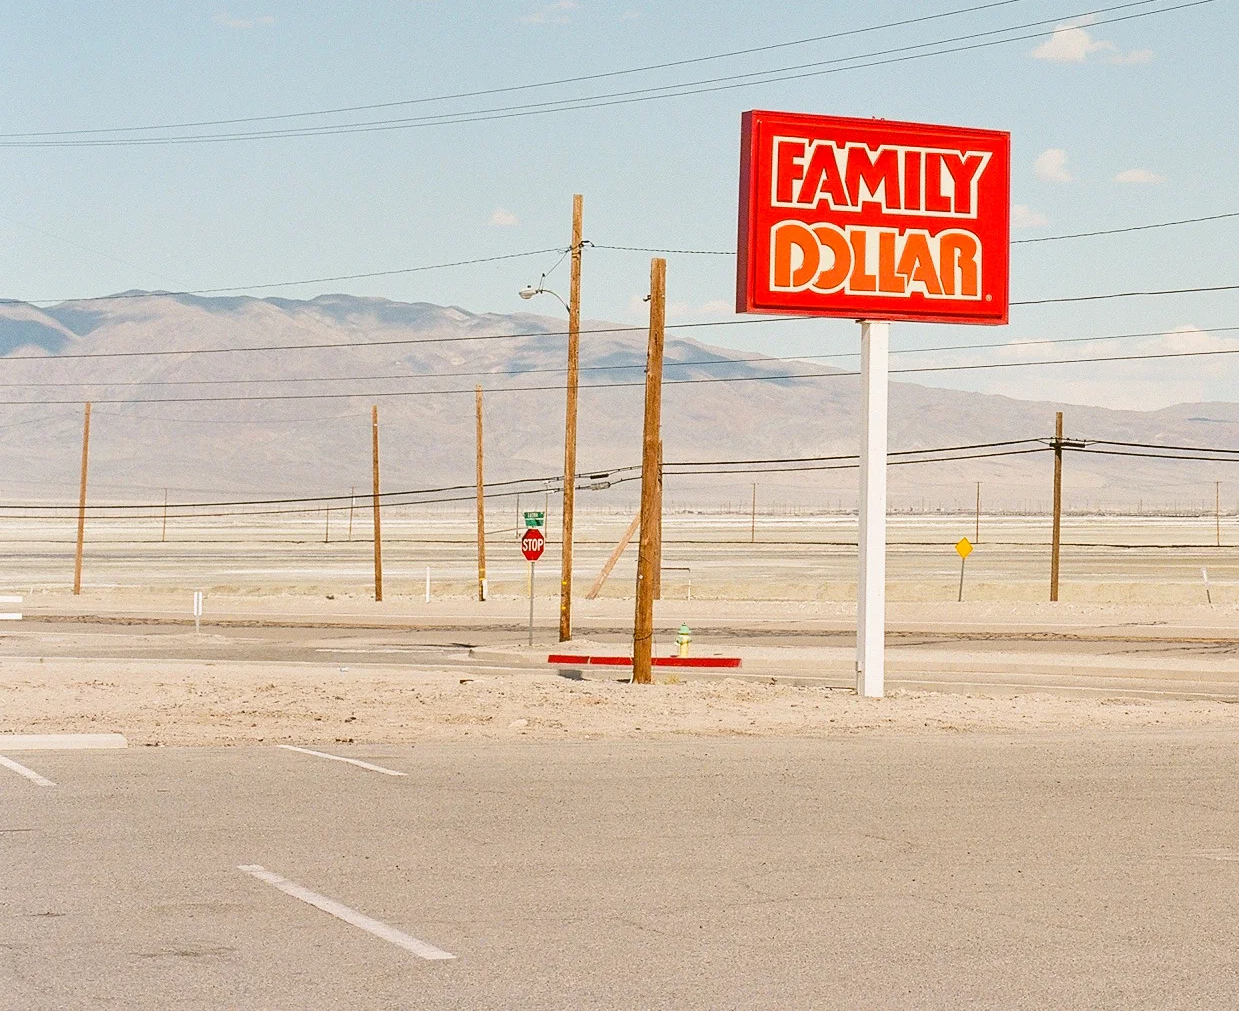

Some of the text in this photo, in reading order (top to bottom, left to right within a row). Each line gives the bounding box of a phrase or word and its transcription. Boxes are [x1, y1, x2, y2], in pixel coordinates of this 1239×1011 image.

[771, 136, 993, 219] FAMILY
[770, 220, 983, 301] DOLLAR
[522, 538, 543, 551] STOP
